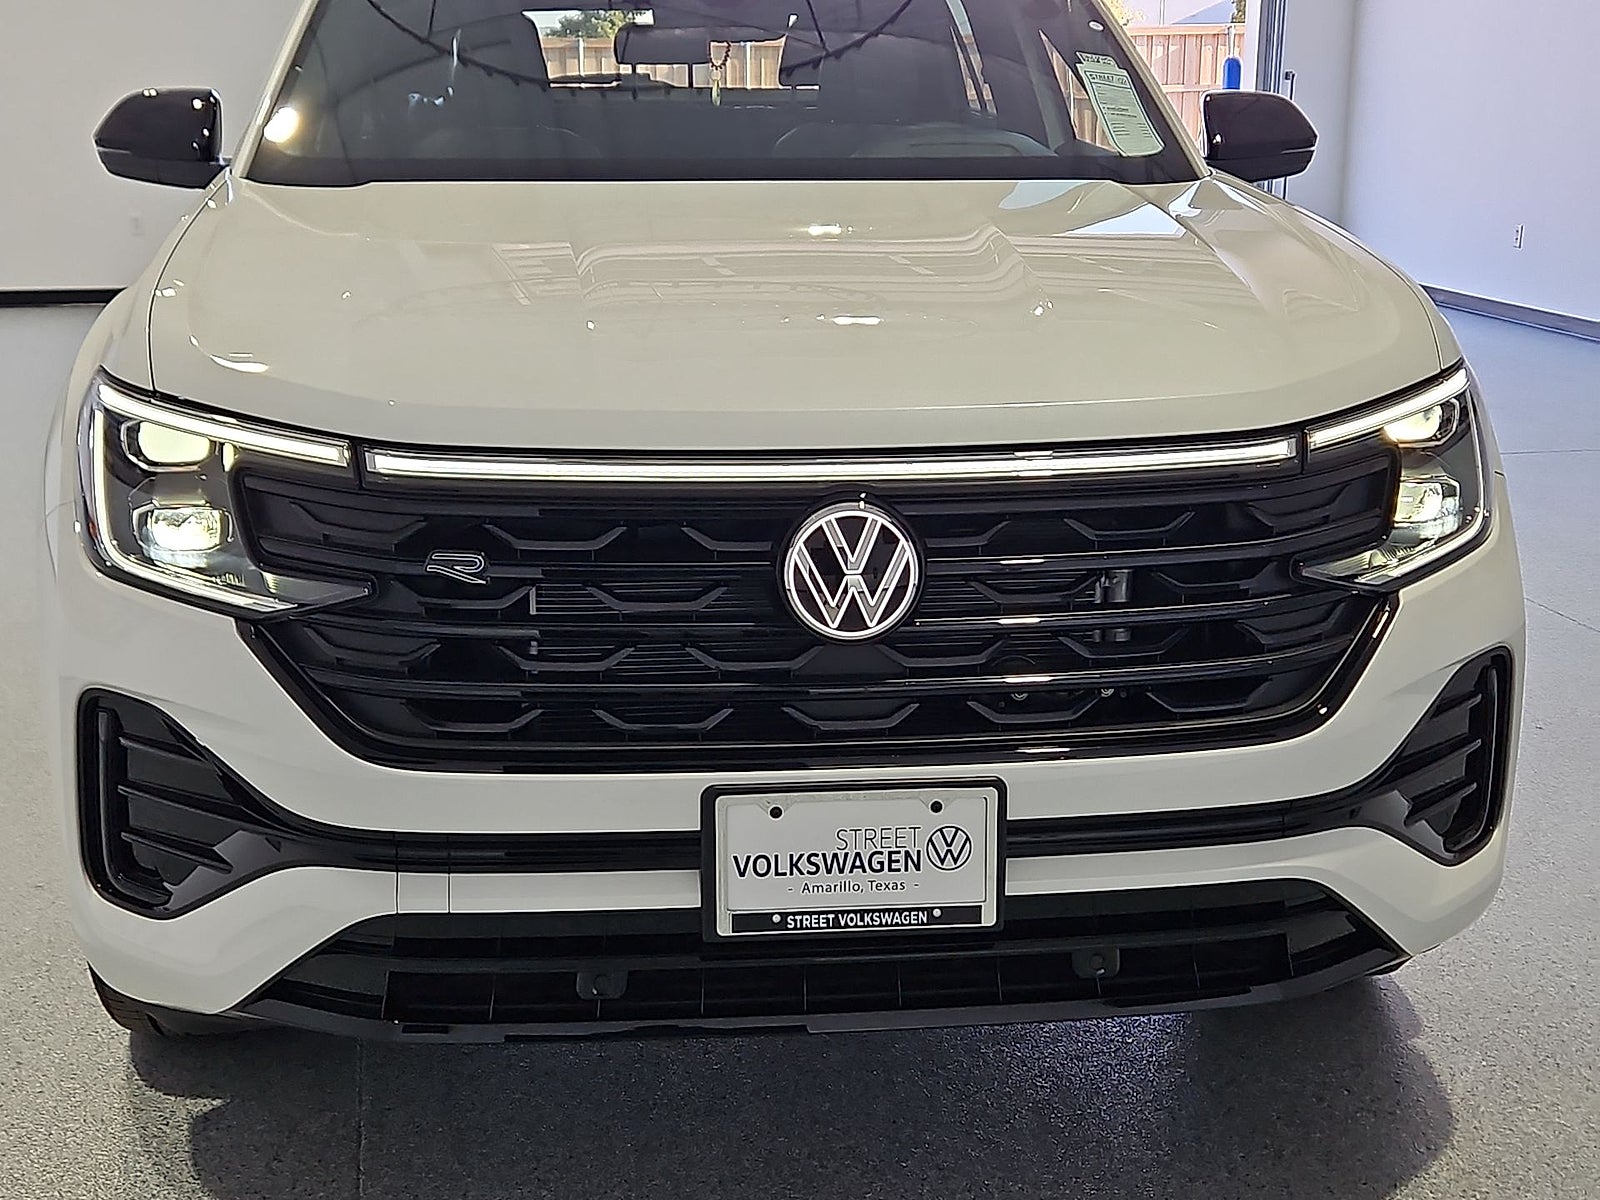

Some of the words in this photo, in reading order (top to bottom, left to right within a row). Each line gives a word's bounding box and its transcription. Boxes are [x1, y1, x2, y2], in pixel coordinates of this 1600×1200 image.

[785, 503, 918, 640] VW
[836, 826, 922, 851] STREET
[926, 825, 972, 871] VW
[733, 849, 922, 877] VOLKSWAGEN
[801, 880, 864, 894] Amarillo,
[868, 880, 906, 892] Texas
[786, 914, 835, 929] STREET
[838, 911, 928, 927] VOLKSWAGEN
